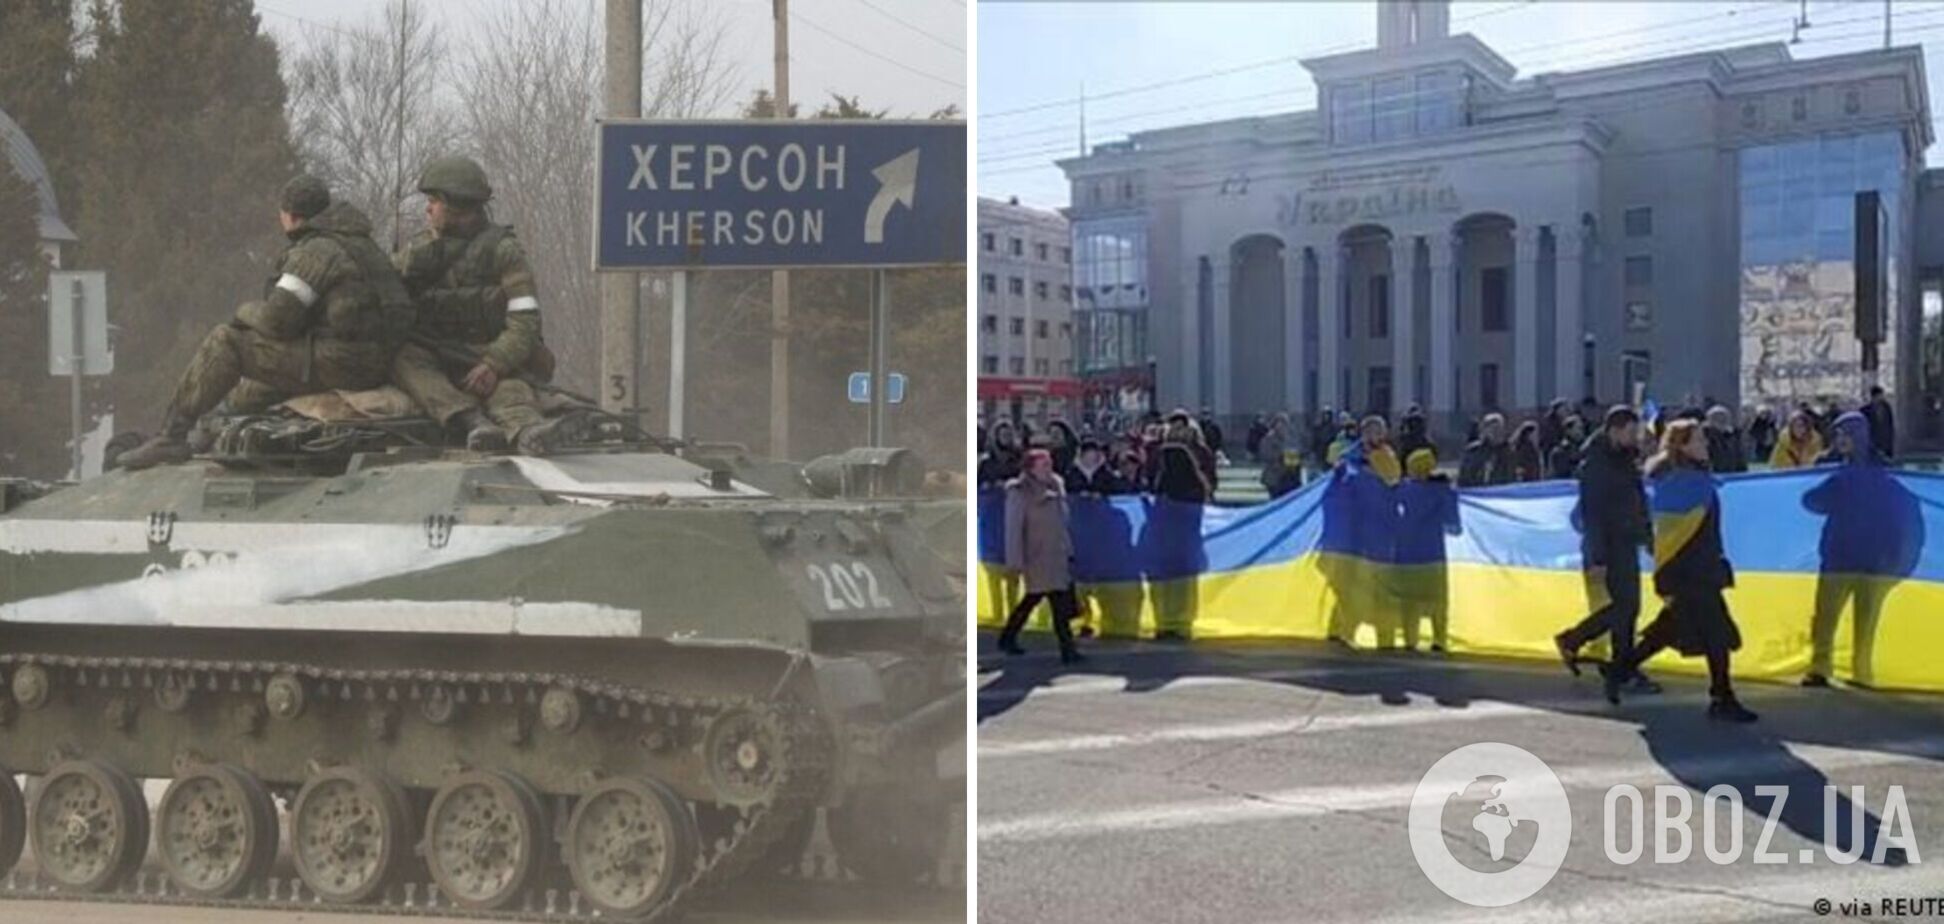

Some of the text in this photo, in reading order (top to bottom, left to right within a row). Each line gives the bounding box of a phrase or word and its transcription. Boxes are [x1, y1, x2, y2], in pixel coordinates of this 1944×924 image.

[627, 143, 846, 192] ХЕРСОН
[626, 208, 824, 246] KHERSON
[609, 374, 627, 402] 3
[806, 561, 893, 611] 202
